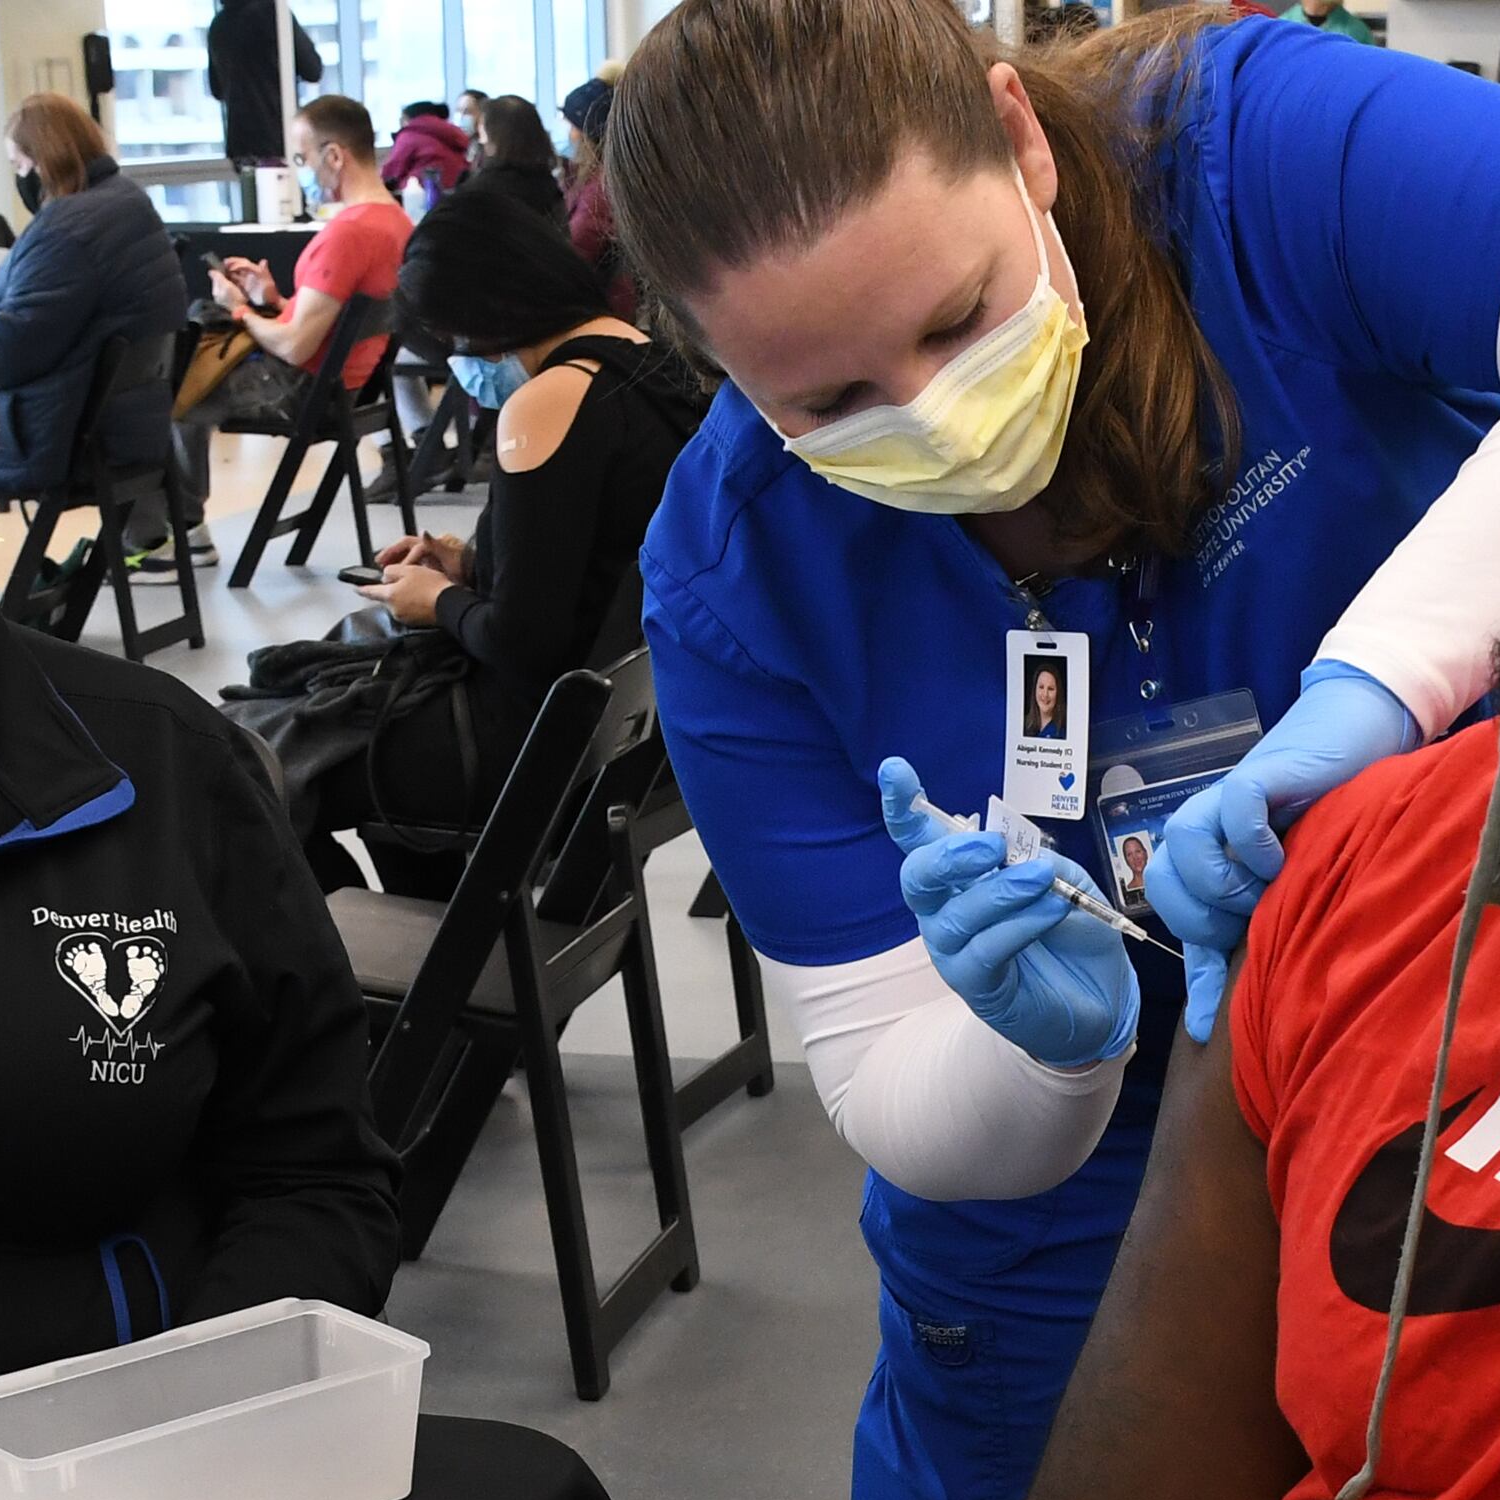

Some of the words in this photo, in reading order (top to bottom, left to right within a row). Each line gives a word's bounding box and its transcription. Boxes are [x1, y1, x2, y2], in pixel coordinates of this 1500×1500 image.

[1051, 802, 1079, 811] HEALTH
[1052, 794, 1079, 803] DENVER
[31, 906, 110, 930] Denver
[113, 909, 178, 934] Health
[89, 1059, 147, 1085] NICU
